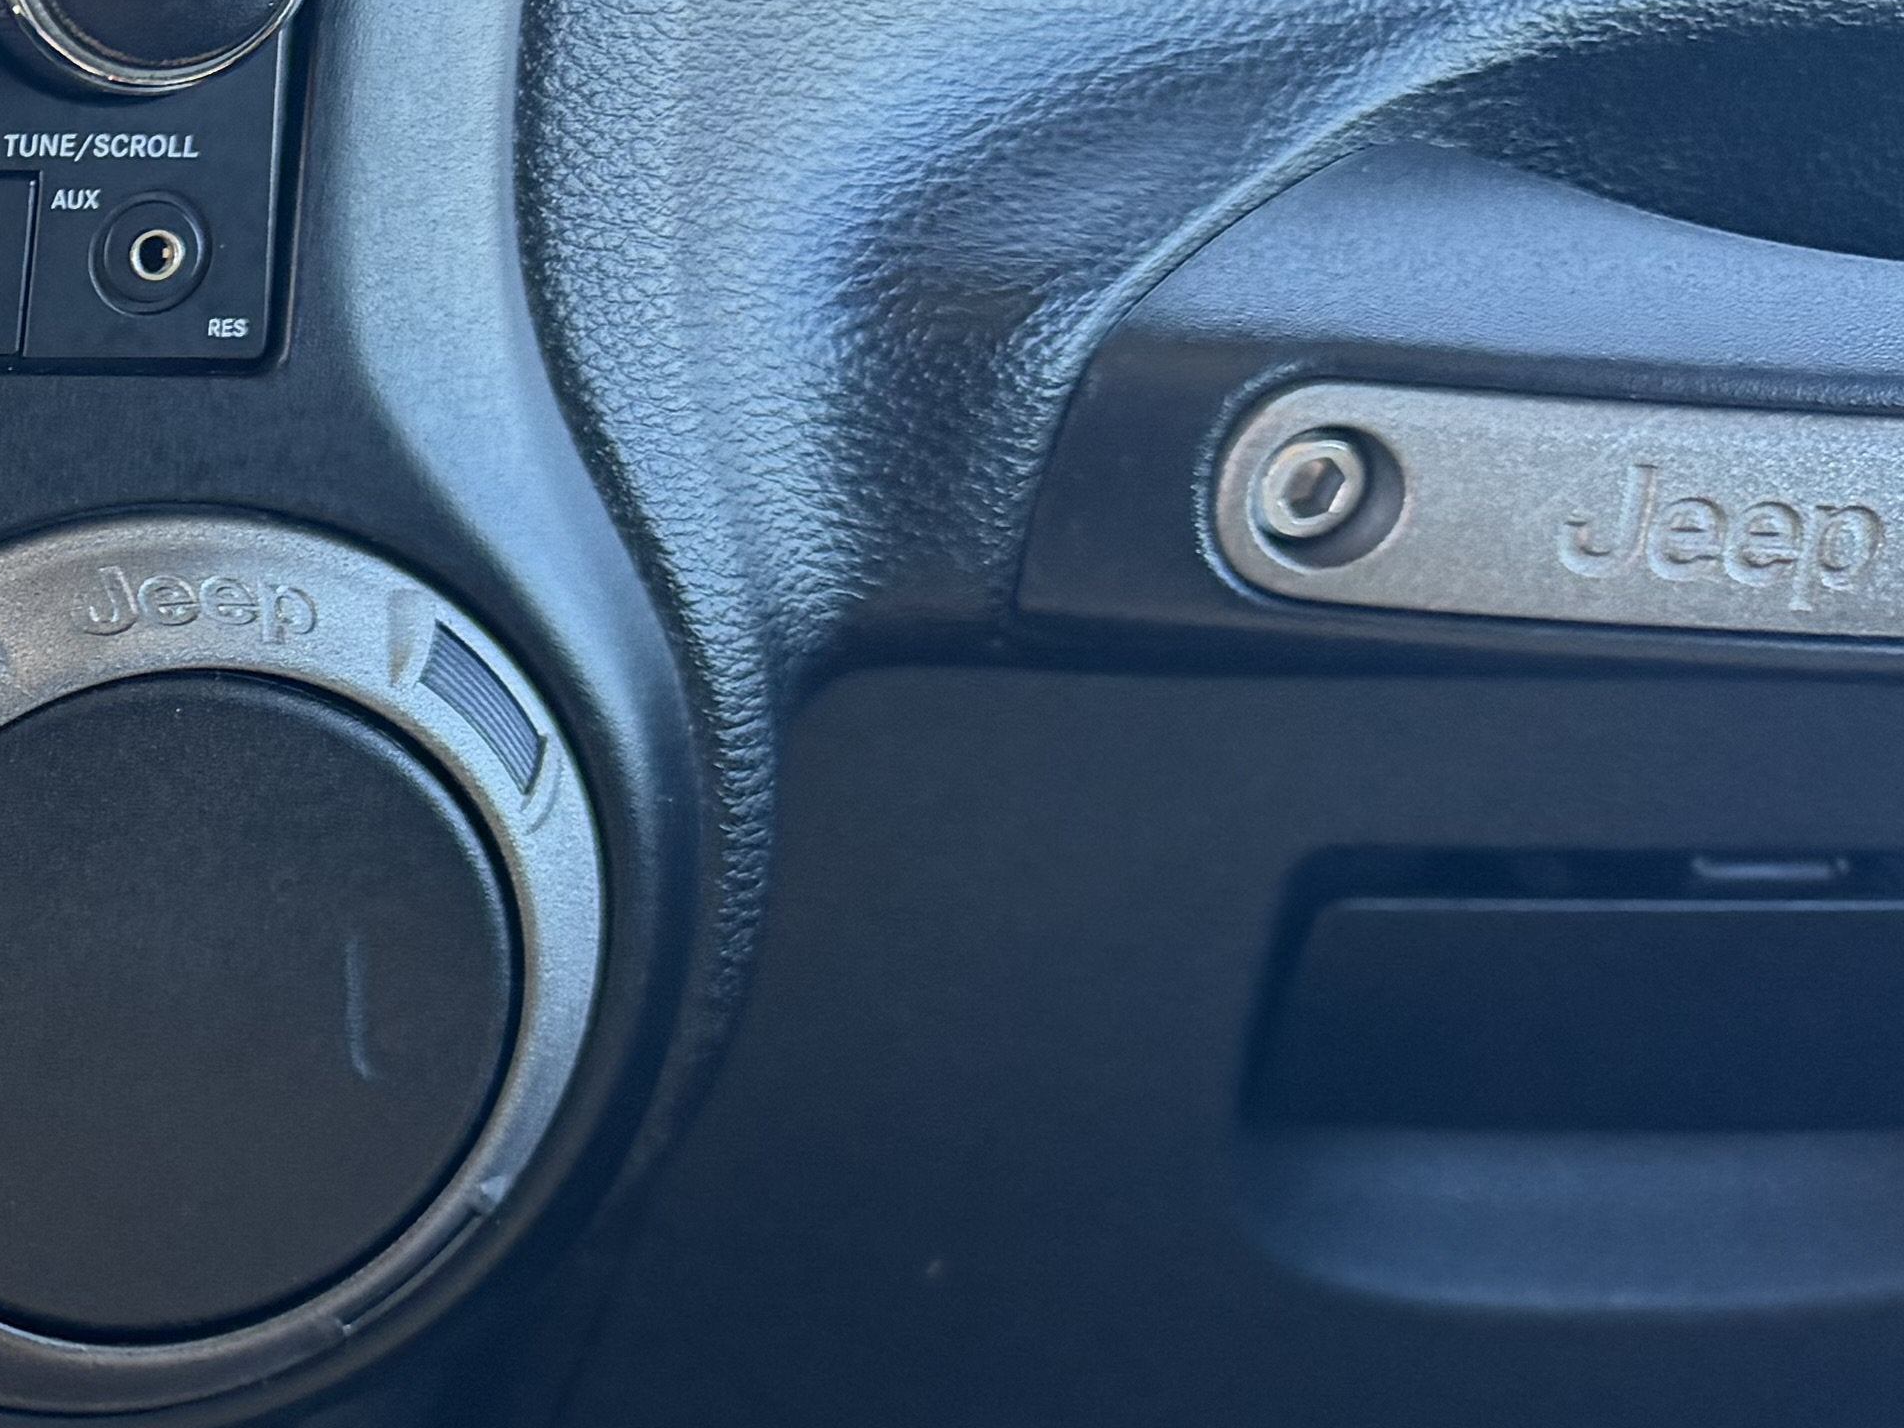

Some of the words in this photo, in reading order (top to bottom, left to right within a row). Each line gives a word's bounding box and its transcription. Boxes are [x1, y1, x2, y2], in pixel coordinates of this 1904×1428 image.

[4, 134, 198, 161] TUNE/SCROLL
[51, 190, 100, 209] AUX
[208, 318, 247, 337] RES
[1556, 461, 1886, 612] Jeep
[73, 566, 318, 640] Jeep
